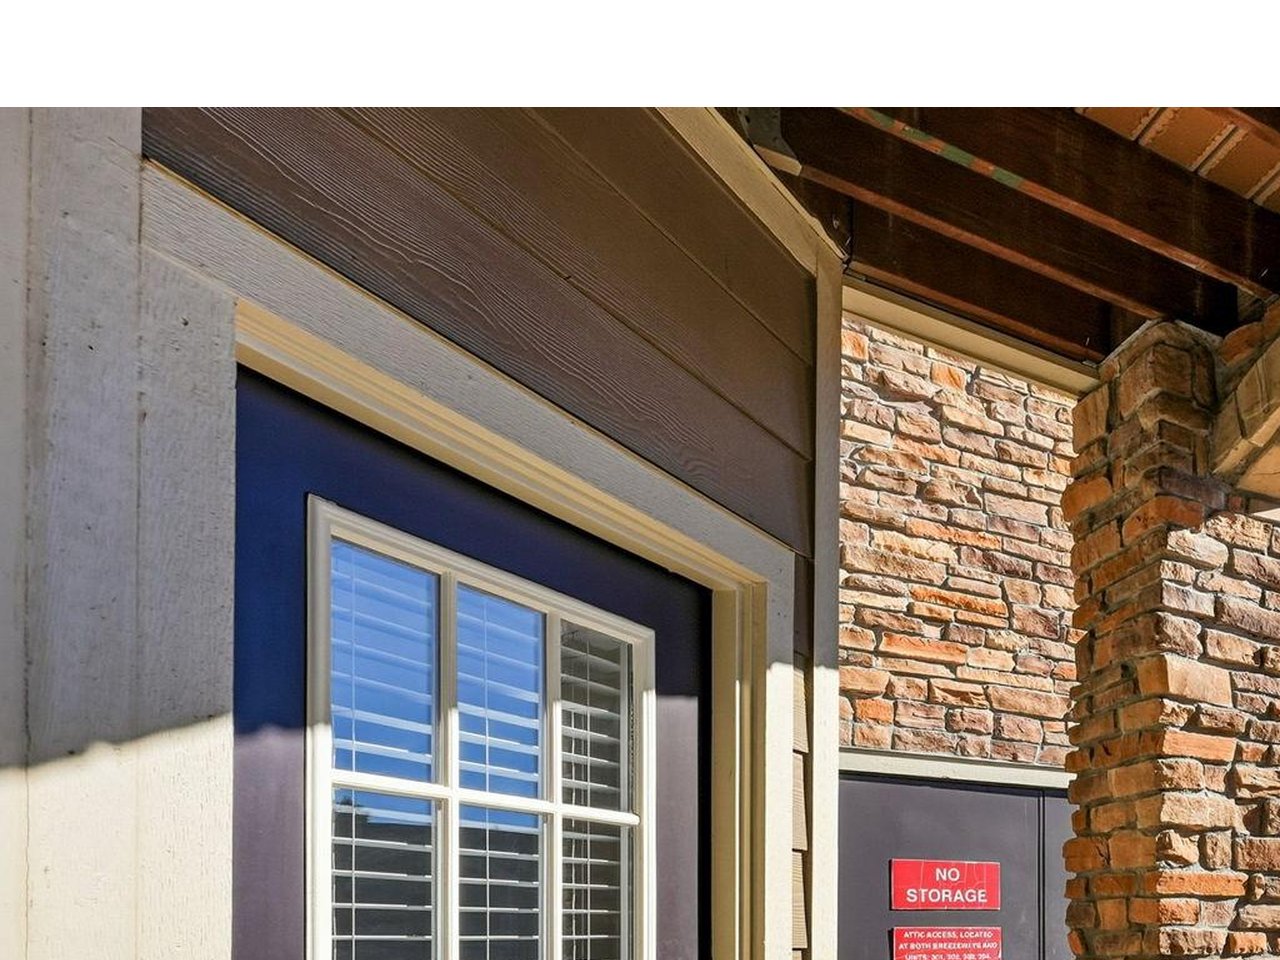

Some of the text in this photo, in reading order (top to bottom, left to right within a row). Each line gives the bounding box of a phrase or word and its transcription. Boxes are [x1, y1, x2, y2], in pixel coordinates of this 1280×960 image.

[935, 867, 961, 882] NO
[906, 888, 988, 903] STORAGE
[903, 931, 925, 939] ATTIC
